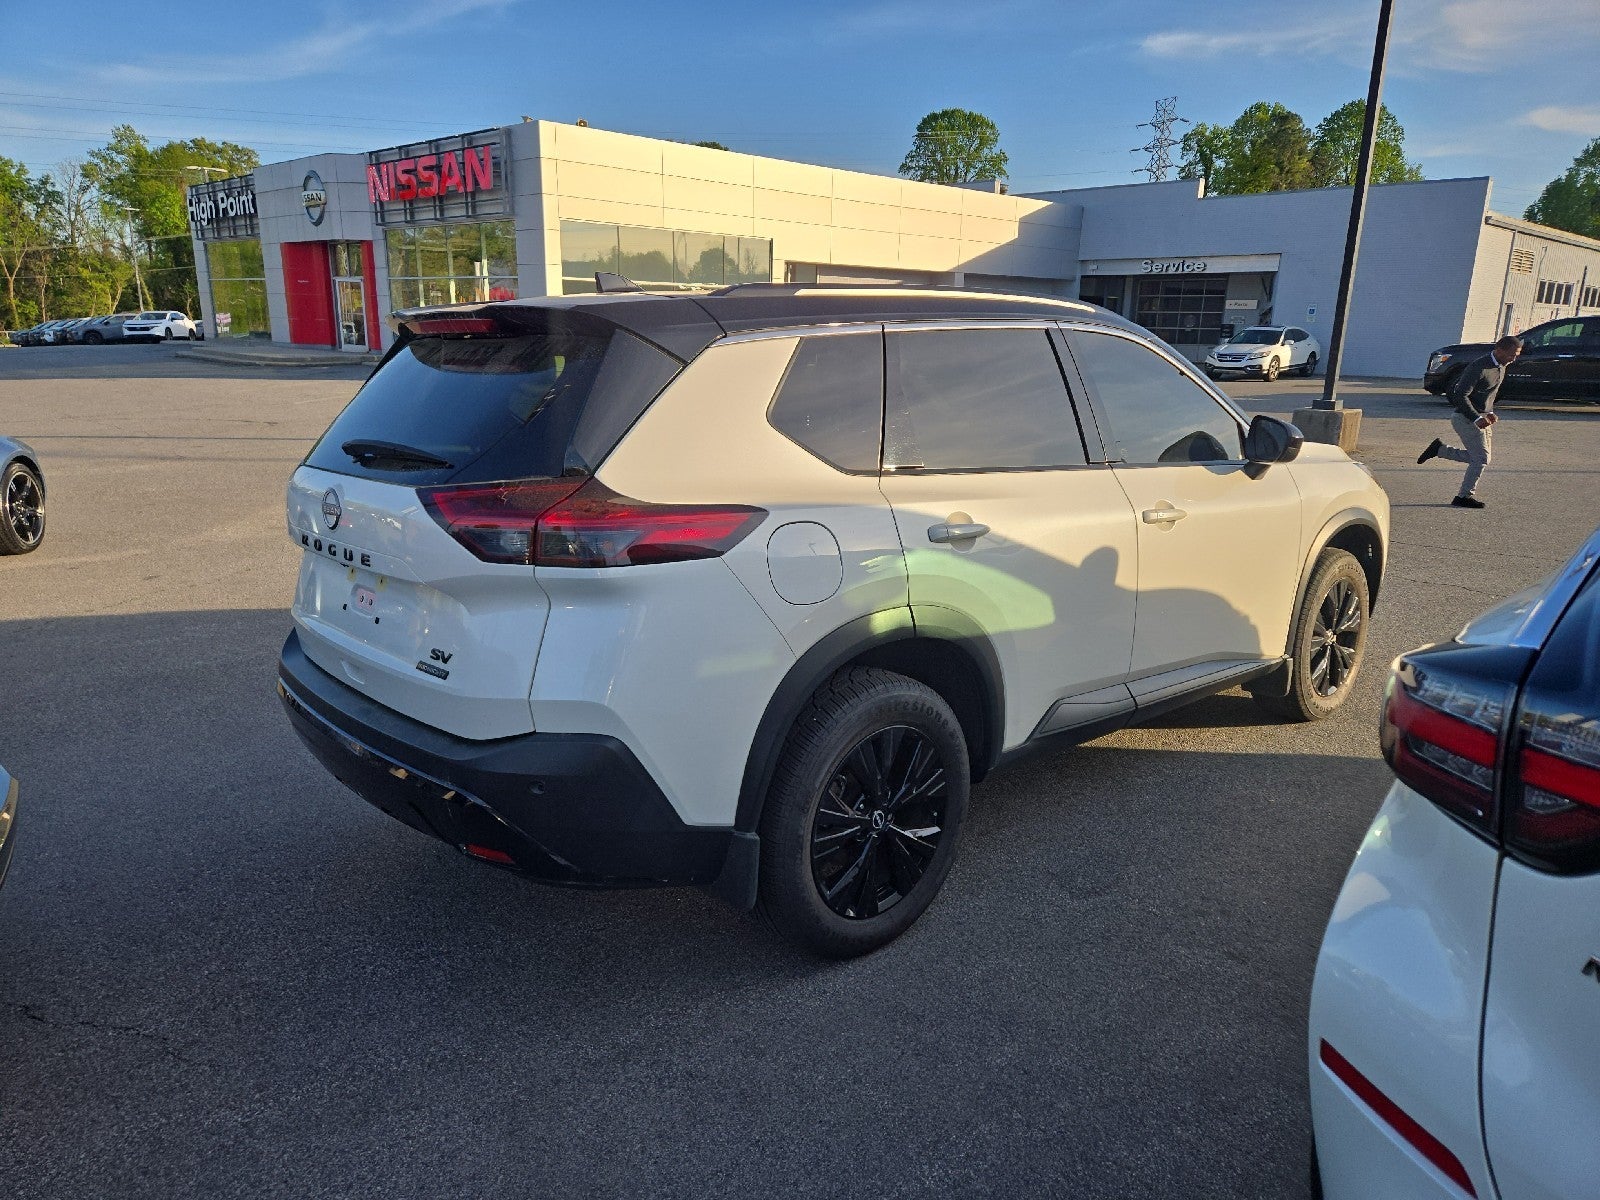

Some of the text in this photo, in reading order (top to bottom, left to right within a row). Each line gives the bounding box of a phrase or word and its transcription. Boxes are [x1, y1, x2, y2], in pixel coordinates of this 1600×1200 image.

[367, 145, 493, 203] NISSAN
[187, 189, 255, 226] High Point
[1141, 259, 1207, 273] Service
[302, 533, 371, 567] ROGUE
[430, 648, 453, 664] SV
